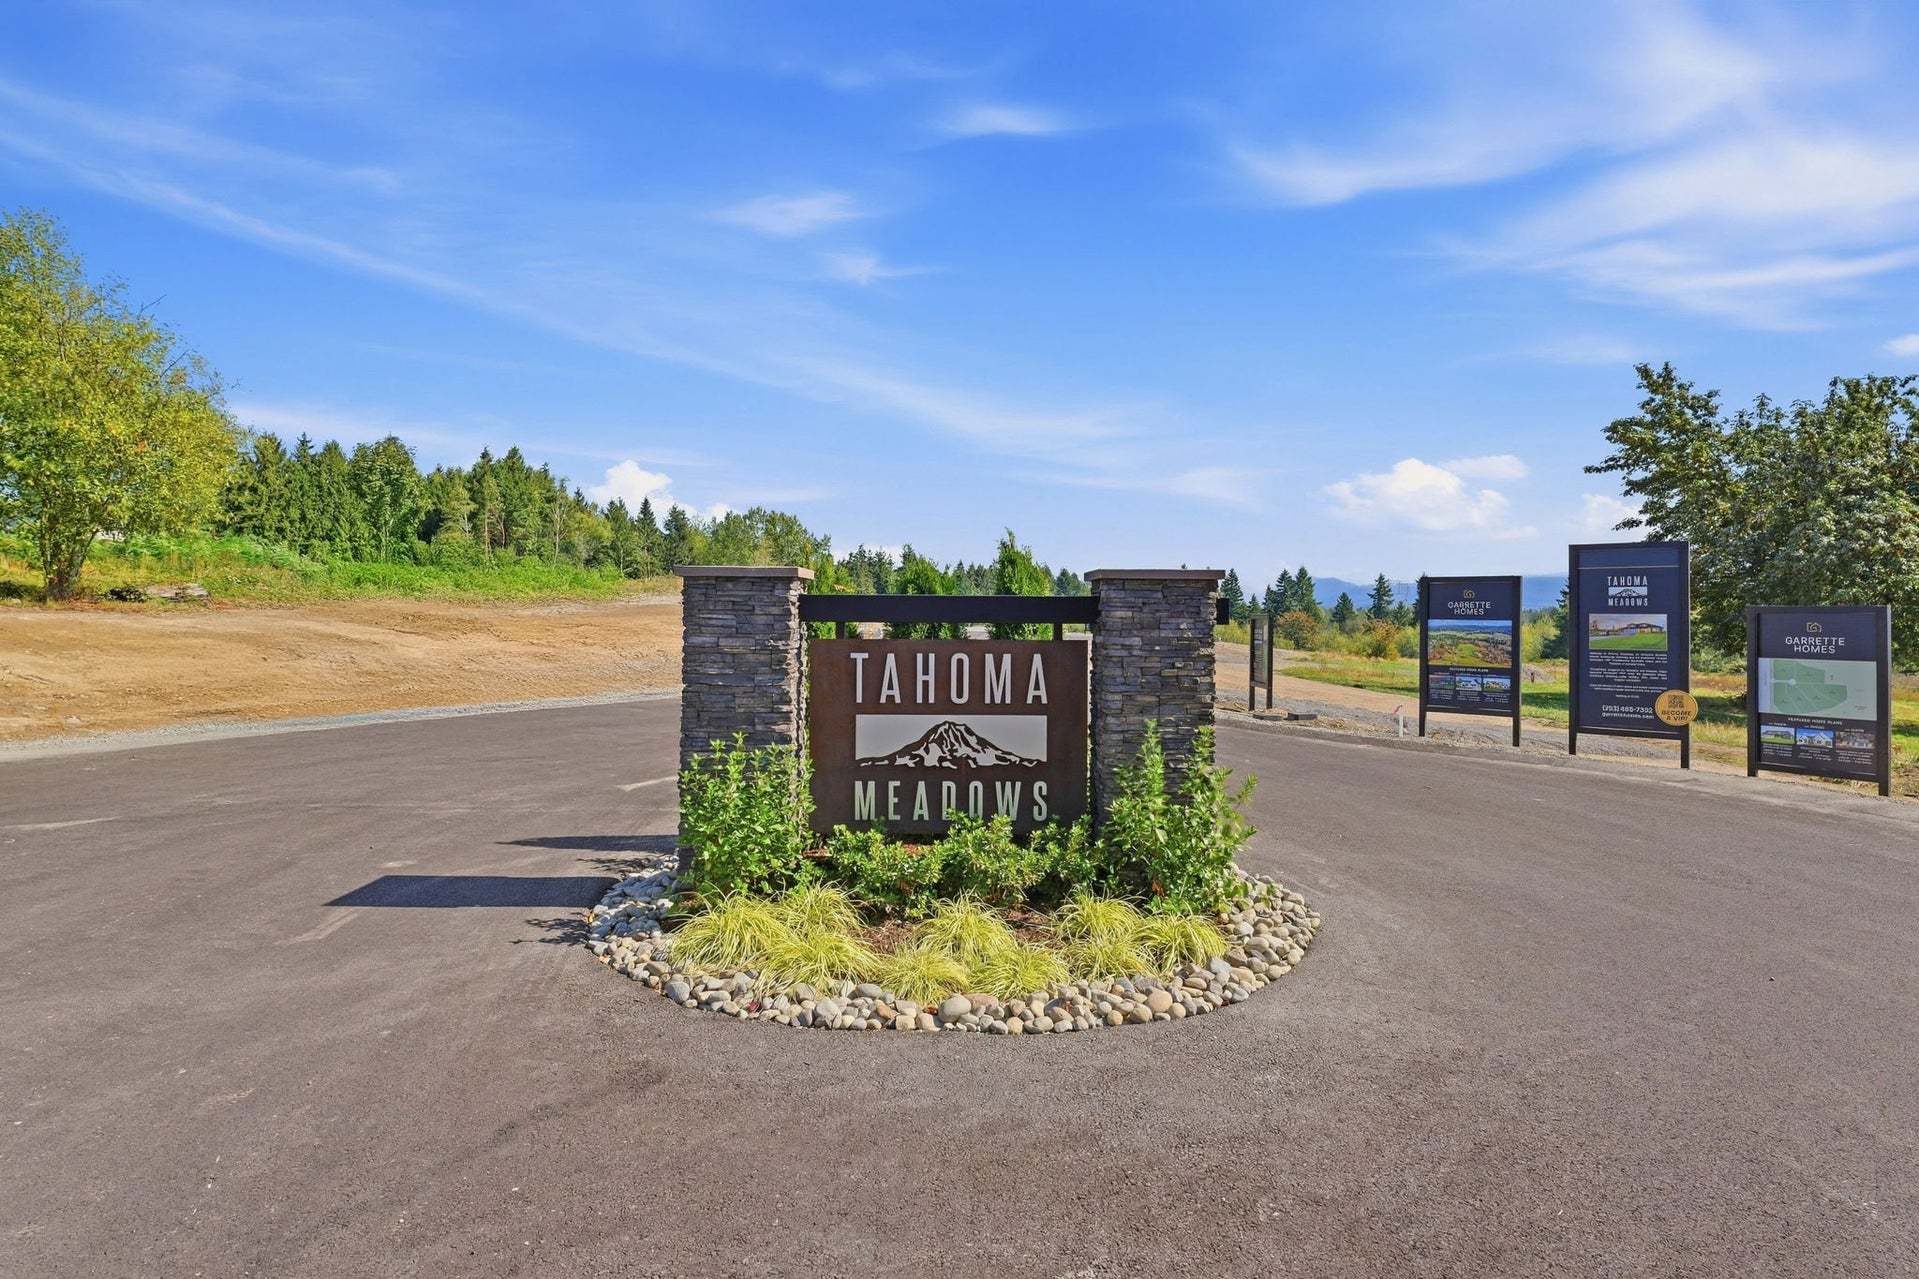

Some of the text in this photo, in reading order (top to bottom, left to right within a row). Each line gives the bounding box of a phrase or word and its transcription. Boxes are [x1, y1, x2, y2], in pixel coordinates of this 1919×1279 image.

[1607, 575, 1648, 586] TAHOMA
[1447, 601, 1491, 609] GARRETTE
[1608, 598, 1648, 607] MEADOWS
[1785, 636, 1845, 646] GARRETTE
[1793, 645, 1836, 654] HOMES
[850, 653, 1048, 704] TAHOMA
[854, 781, 1048, 821] MEADOWS
